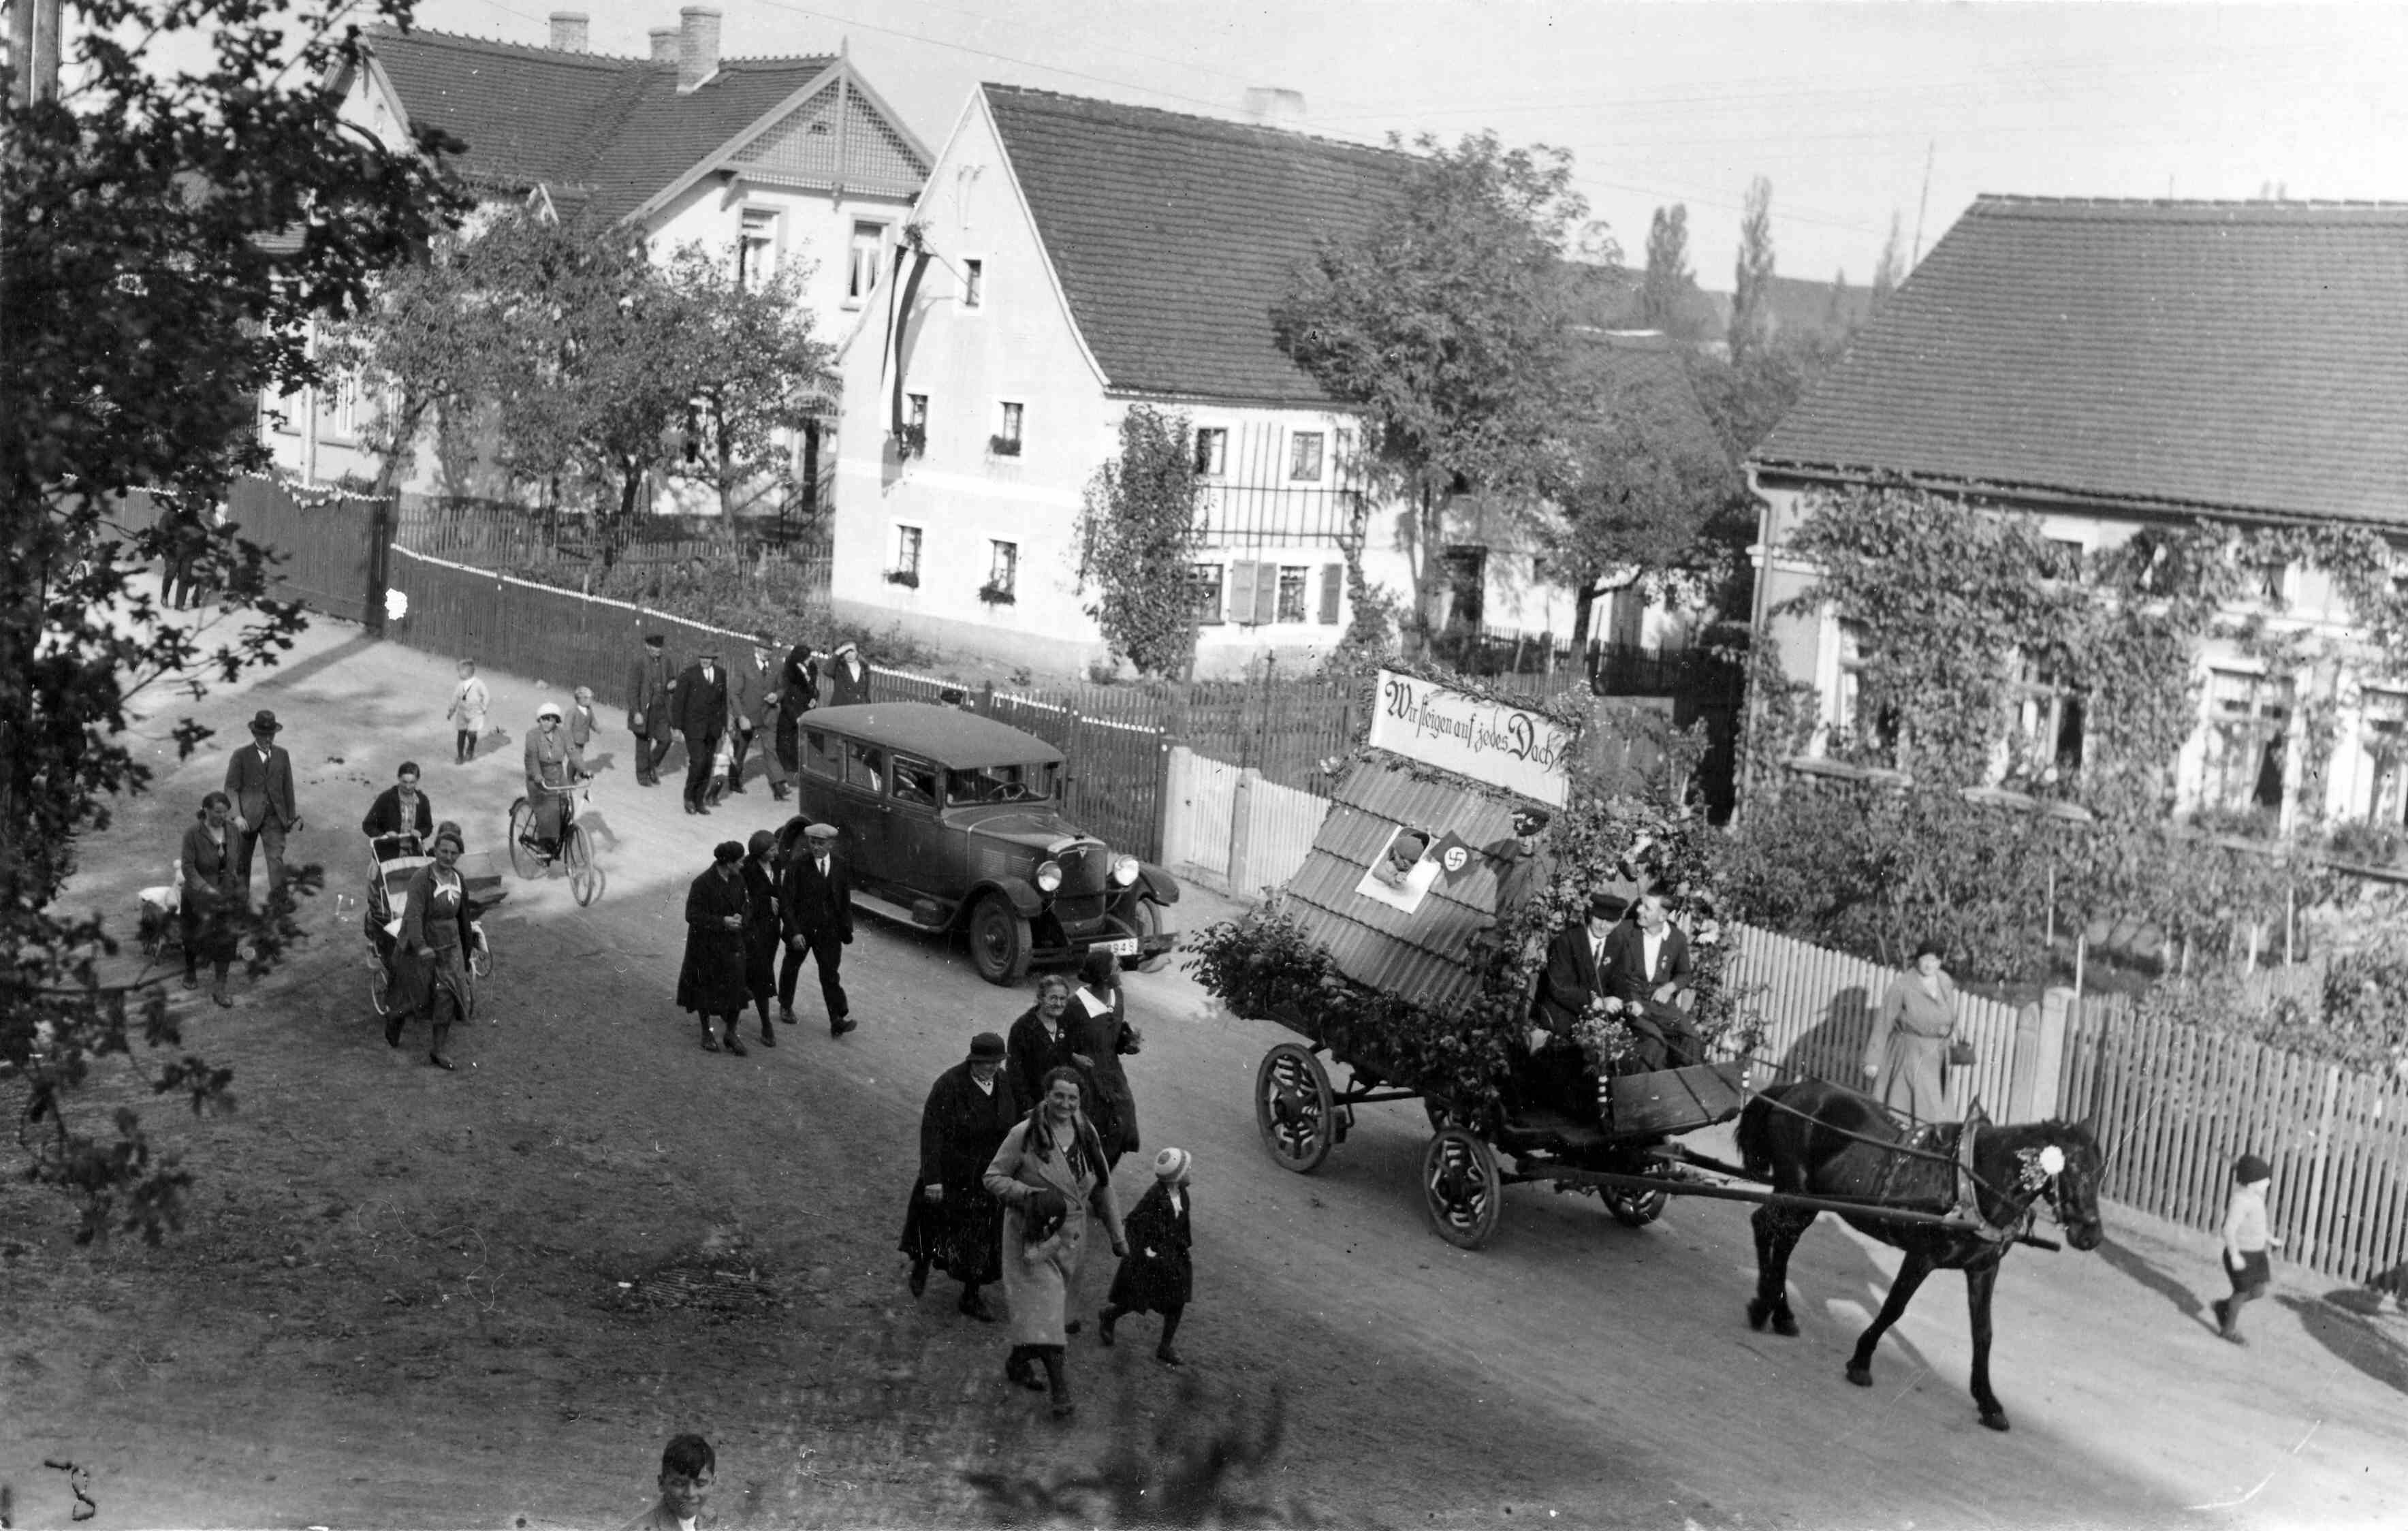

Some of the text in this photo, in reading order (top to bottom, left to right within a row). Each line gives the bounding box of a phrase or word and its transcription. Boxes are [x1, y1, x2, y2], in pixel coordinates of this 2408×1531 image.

[1385, 680, 1418, 723] Wir
[1454, 714, 1476, 748] auf
[1474, 707, 1508, 753] jedes
[1508, 713, 1553, 774] Dach
